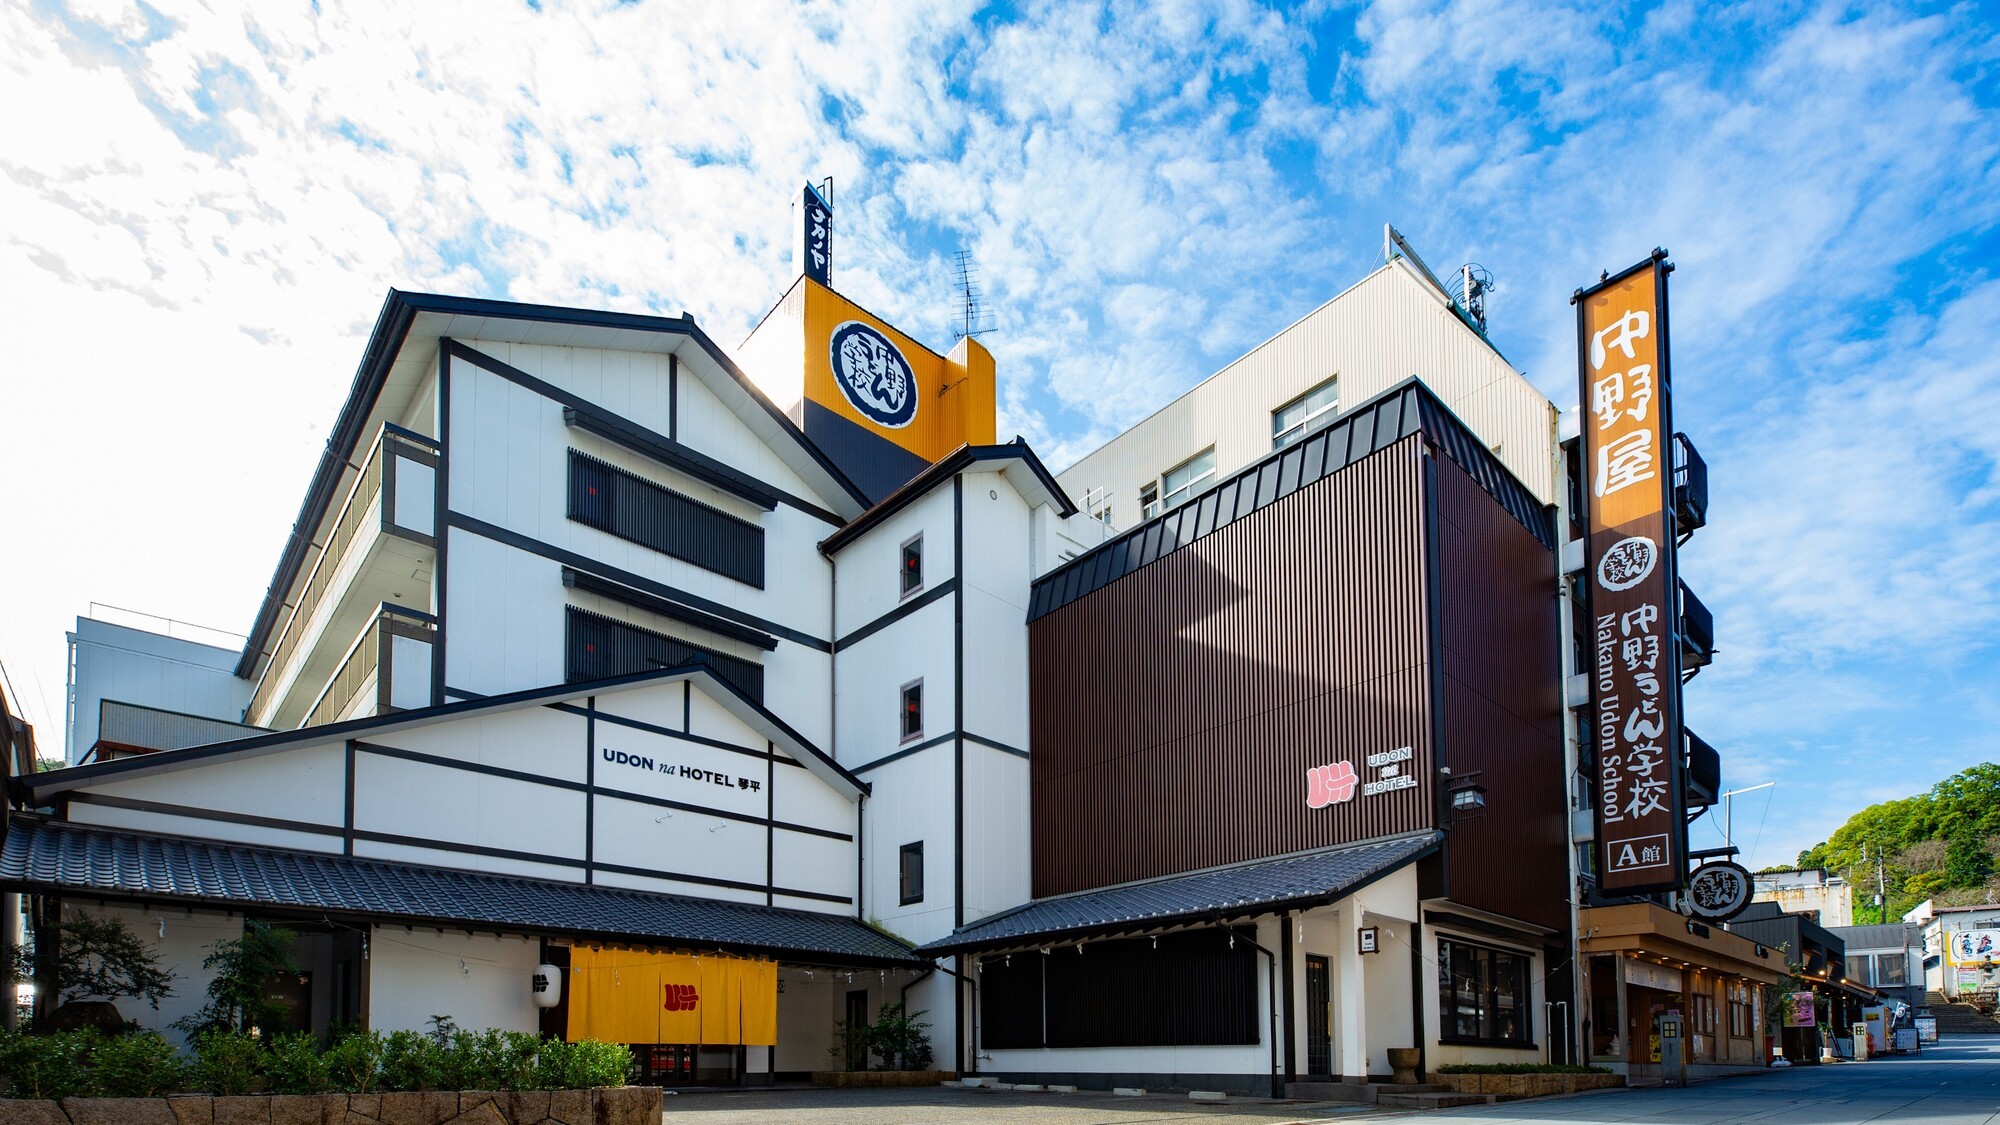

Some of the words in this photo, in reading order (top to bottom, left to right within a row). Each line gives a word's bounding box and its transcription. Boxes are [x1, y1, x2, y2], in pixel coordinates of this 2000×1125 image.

[857, 332, 900, 411] うどん
[875, 344, 905, 399] 中野
[1590, 309, 1656, 498] 中野屋
[1597, 611, 1618, 693] Nakano
[1600, 694, 1621, 752] Udon
[1621, 602, 1670, 820] 中野うどん学校
[603, 748, 654, 771] UDON
[658, 762, 676, 776] na
[679, 764, 735, 788] HOTEL
[738, 777, 761, 793] 琴平
[1364, 775, 1418, 796] HOTEL
[1367, 746, 1413, 768] UDON
[1601, 755, 1625, 825] School
[1615, 843, 1661, 867] A館
